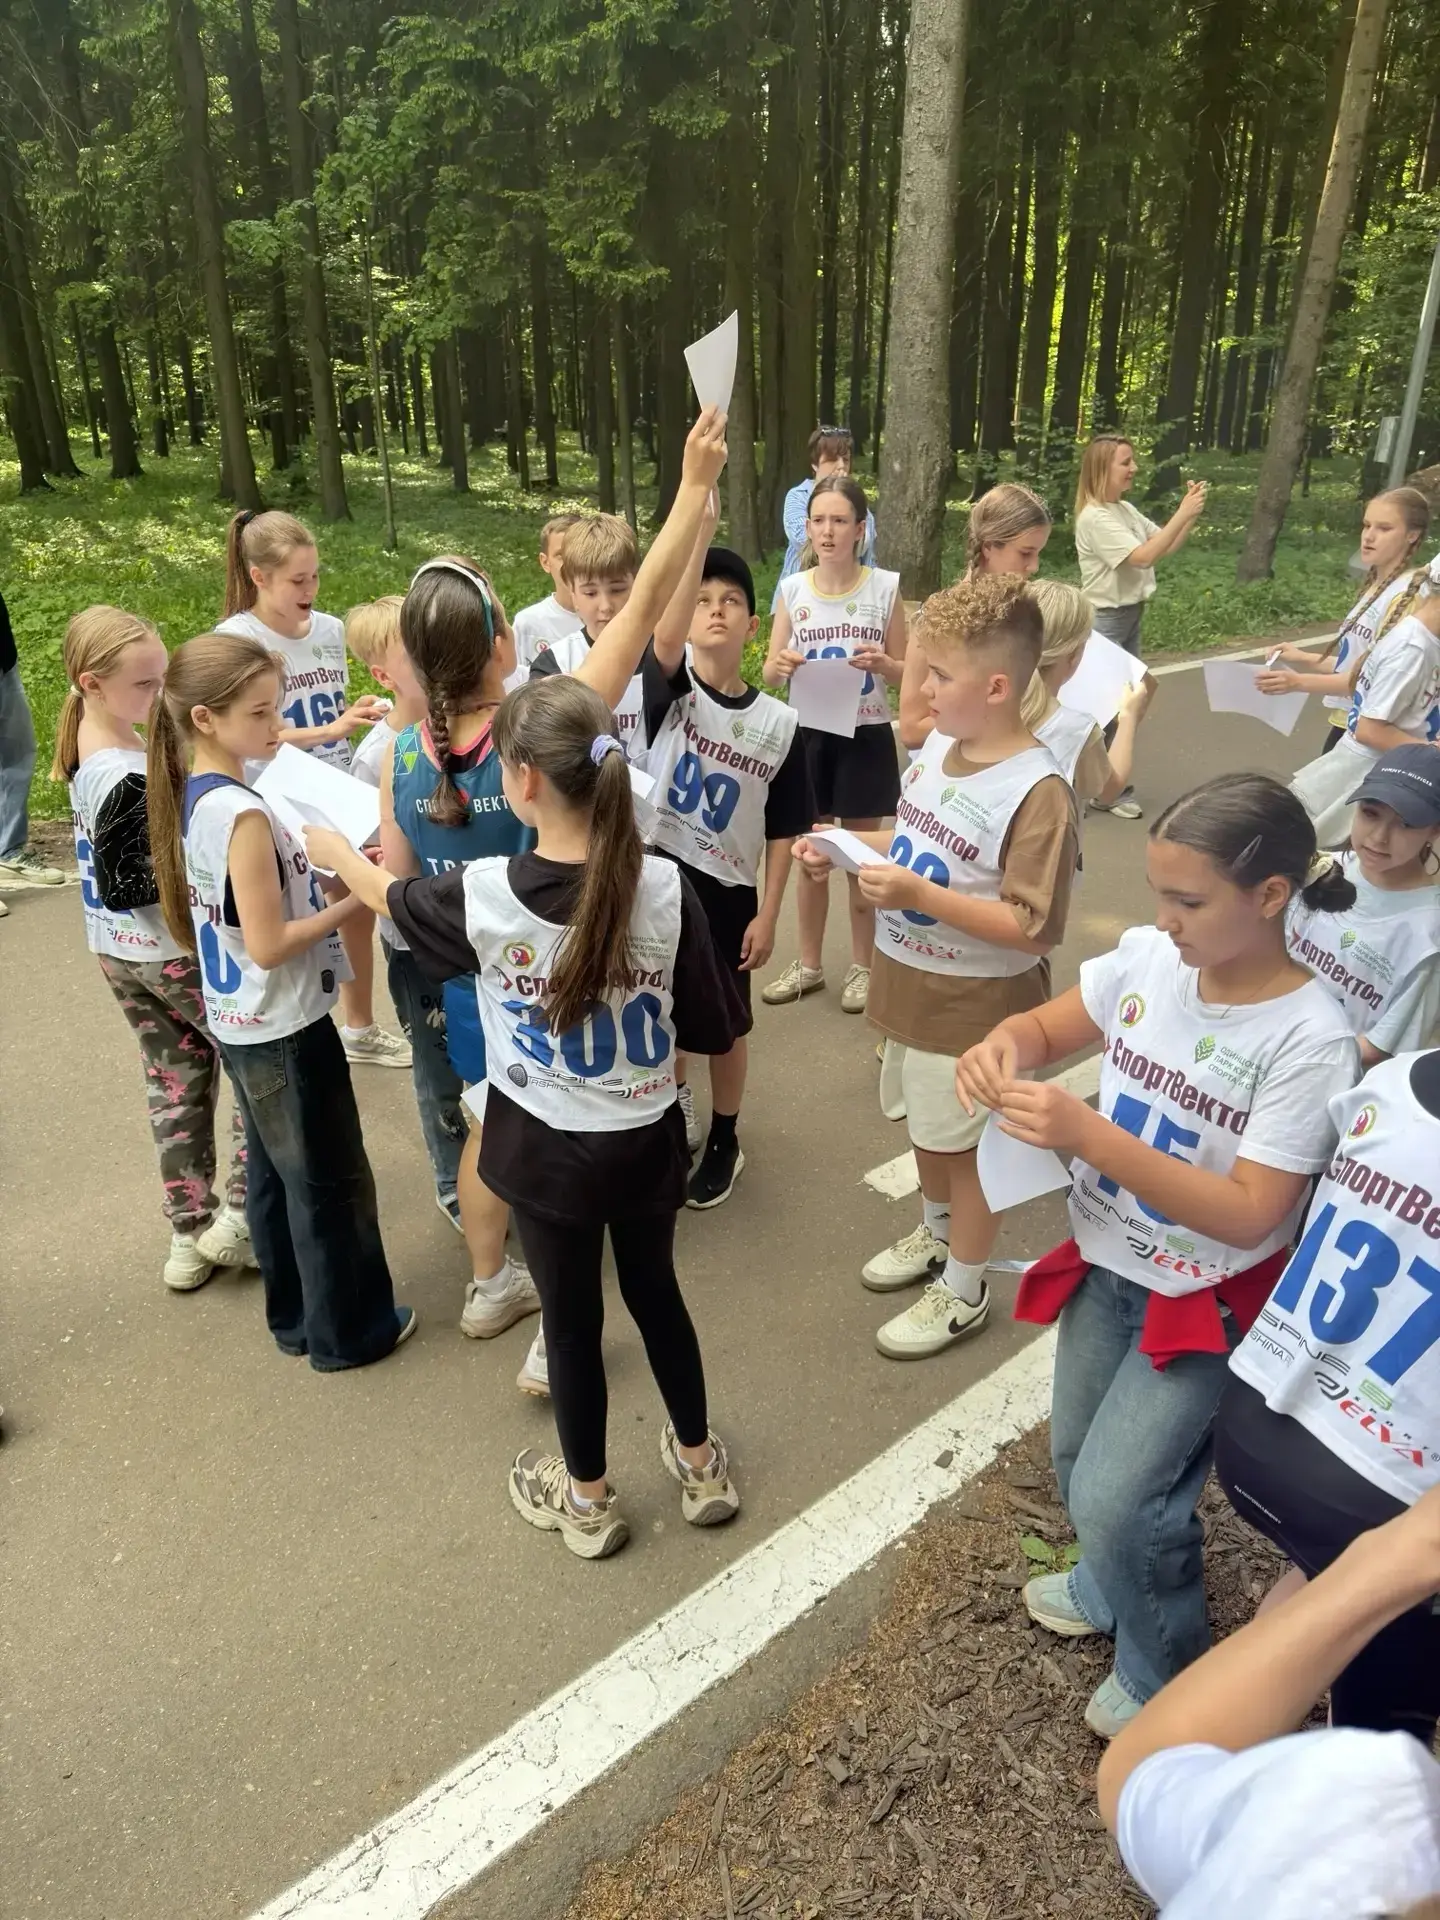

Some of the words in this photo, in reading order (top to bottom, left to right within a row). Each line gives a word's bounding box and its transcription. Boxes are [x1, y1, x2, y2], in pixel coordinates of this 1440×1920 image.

[668, 751, 741, 834] 99
[1214, 1055, 1234, 1070] ПАРК
[1080, 1179, 1154, 1237] SPINE
[1272, 1202, 1440, 1387] 137
[1260, 1308, 1351, 1376] SPINE
